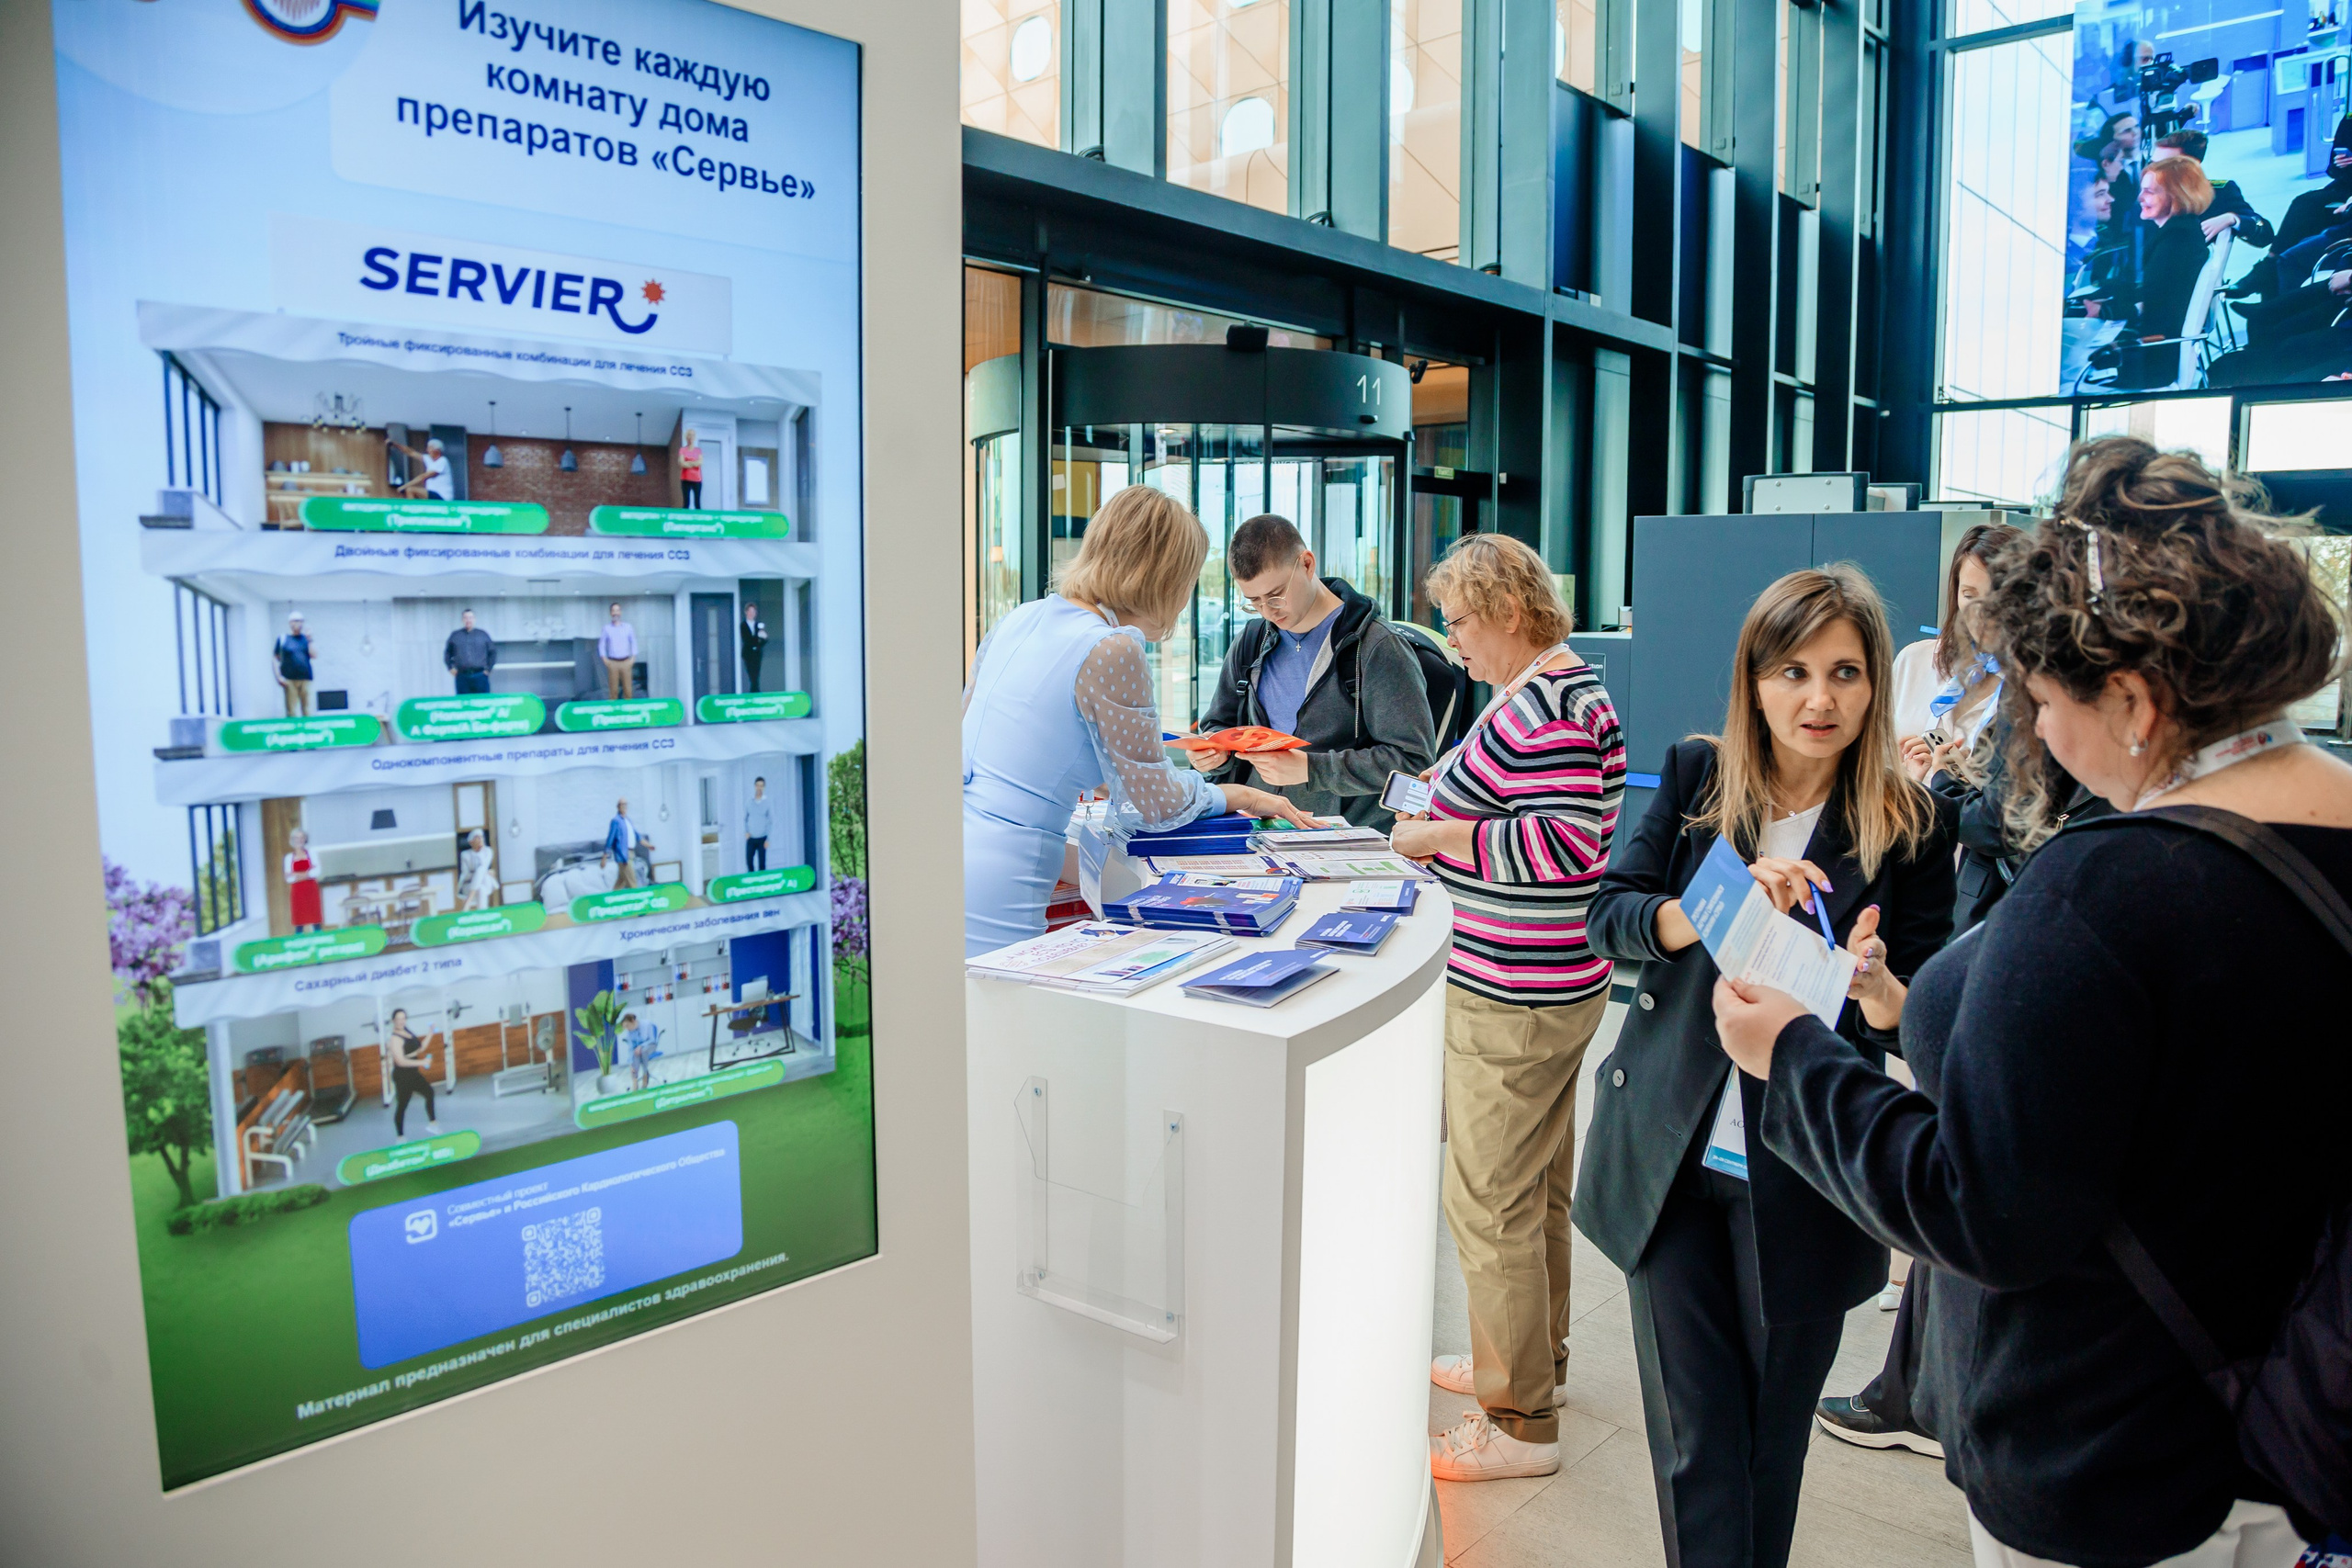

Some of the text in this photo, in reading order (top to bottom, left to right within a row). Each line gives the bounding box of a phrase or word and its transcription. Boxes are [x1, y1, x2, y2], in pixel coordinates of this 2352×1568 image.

[458, 0, 772, 103] Изучите каждую
[486, 62, 750, 143] комнату дома
[396, 96, 817, 201] препаратов «Сервье»
[358, 245, 660, 336] SERVIER
[338, 332, 400, 348] Тройные
[404, 339, 512, 360] фиксированные
[516, 351, 591, 367] комбинации
[594, 360, 616, 370] для
[619, 362, 667, 375] лечения
[1357, 375, 1381, 405] 11
[334, 545, 400, 558] Двойные
[404, 546, 511, 560] фиксированные
[515, 547, 589, 561] комбинации
[593, 550, 615, 561] для
[618, 551, 664, 560] лечения
[371, 751, 503, 770] Однокомпонентные
[506, 746, 574, 761] препараты
[577, 742, 599, 756] для
[603, 739, 649, 753] лечения
[619, 908, 780, 942] Хронические заболевания вен
[295, 957, 462, 992] Сахарный диабет 2 типа
[447, 1181, 548, 1215] Совместный проект
[514, 1186, 580, 1211] Российского
[581, 1160, 677, 1193] Кардиологического
[678, 1148, 726, 1168] Общества
[296, 1252, 789, 1420] Материал предназначен для специалистов здравоохранения.
